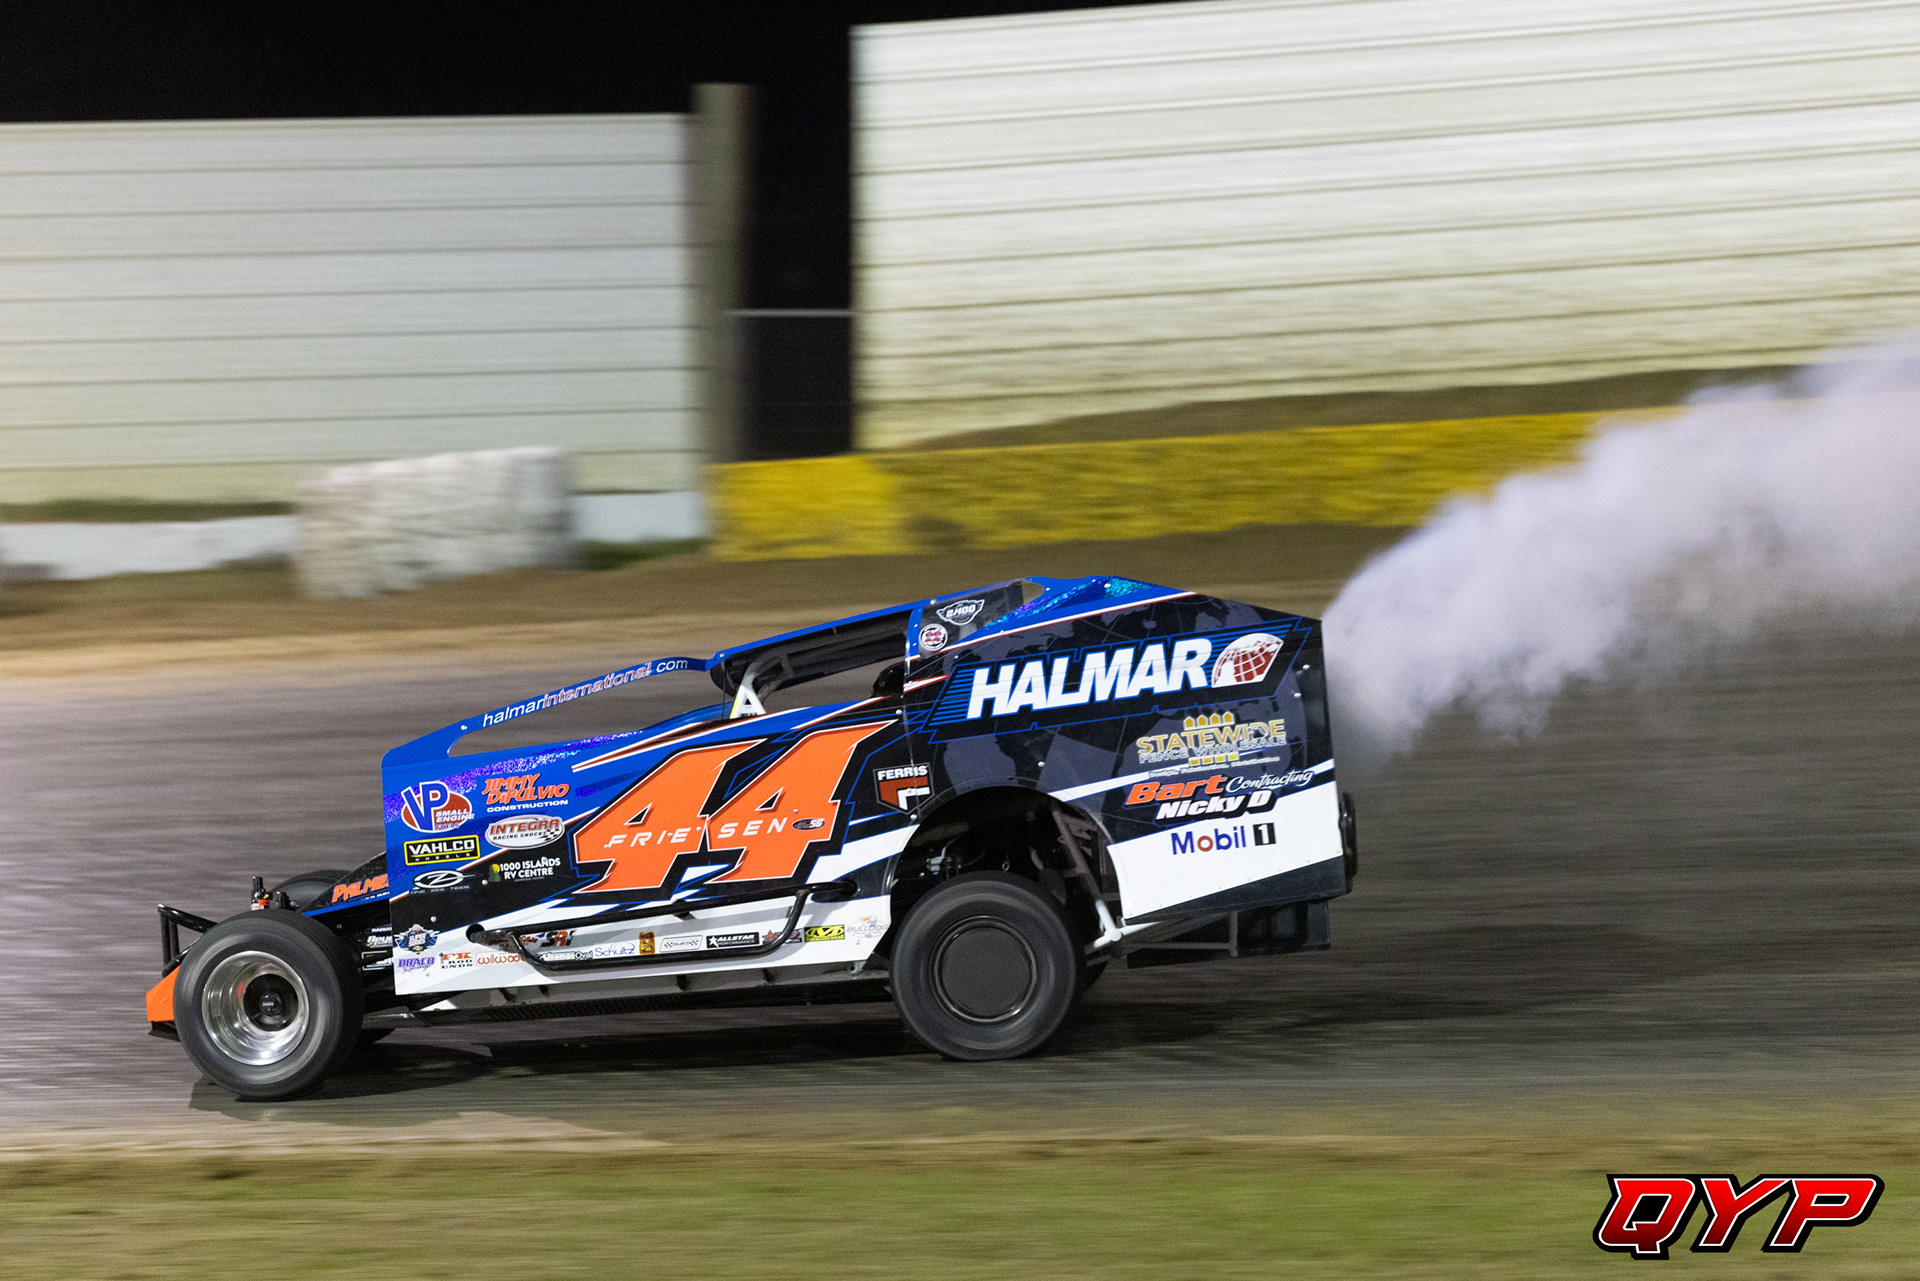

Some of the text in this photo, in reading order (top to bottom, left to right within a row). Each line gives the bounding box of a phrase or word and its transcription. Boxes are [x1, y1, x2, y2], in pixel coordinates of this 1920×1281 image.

[967, 638, 1213, 719] HALMAR
[1136, 719, 1285, 753] STATEWIDE
[1138, 735, 1287, 764] FENCE WHOLESALE
[877, 765, 928, 781] FERRIS
[482, 774, 541, 795] JIMMY
[1125, 769, 1315, 805] Bart Contracting
[487, 800, 569, 812] CONSTRUCTION
[574, 719, 898, 894] 44
[1247, 790, 1272, 807] D
[401, 781, 451, 833] VP
[436, 809, 469, 818] SMALL
[436, 813, 475, 822] ENGINE
[490, 819, 560, 835] INTEGRA
[409, 839, 474, 855] VAHLCO
[1171, 823, 1273, 855] Mobil 1
[500, 857, 561, 872] 1000 ISLANDS
[504, 871, 516, 880] RV
[518, 867, 553, 878] CENTRE
[332, 874, 389, 903] PALME
[717, 934, 756, 942] ALLSTAR
[443, 952, 472, 960] FK
[477, 954, 526, 965] wilwoo
[595, 946, 636, 957] Schultz
[398, 957, 435, 968] DRACO
